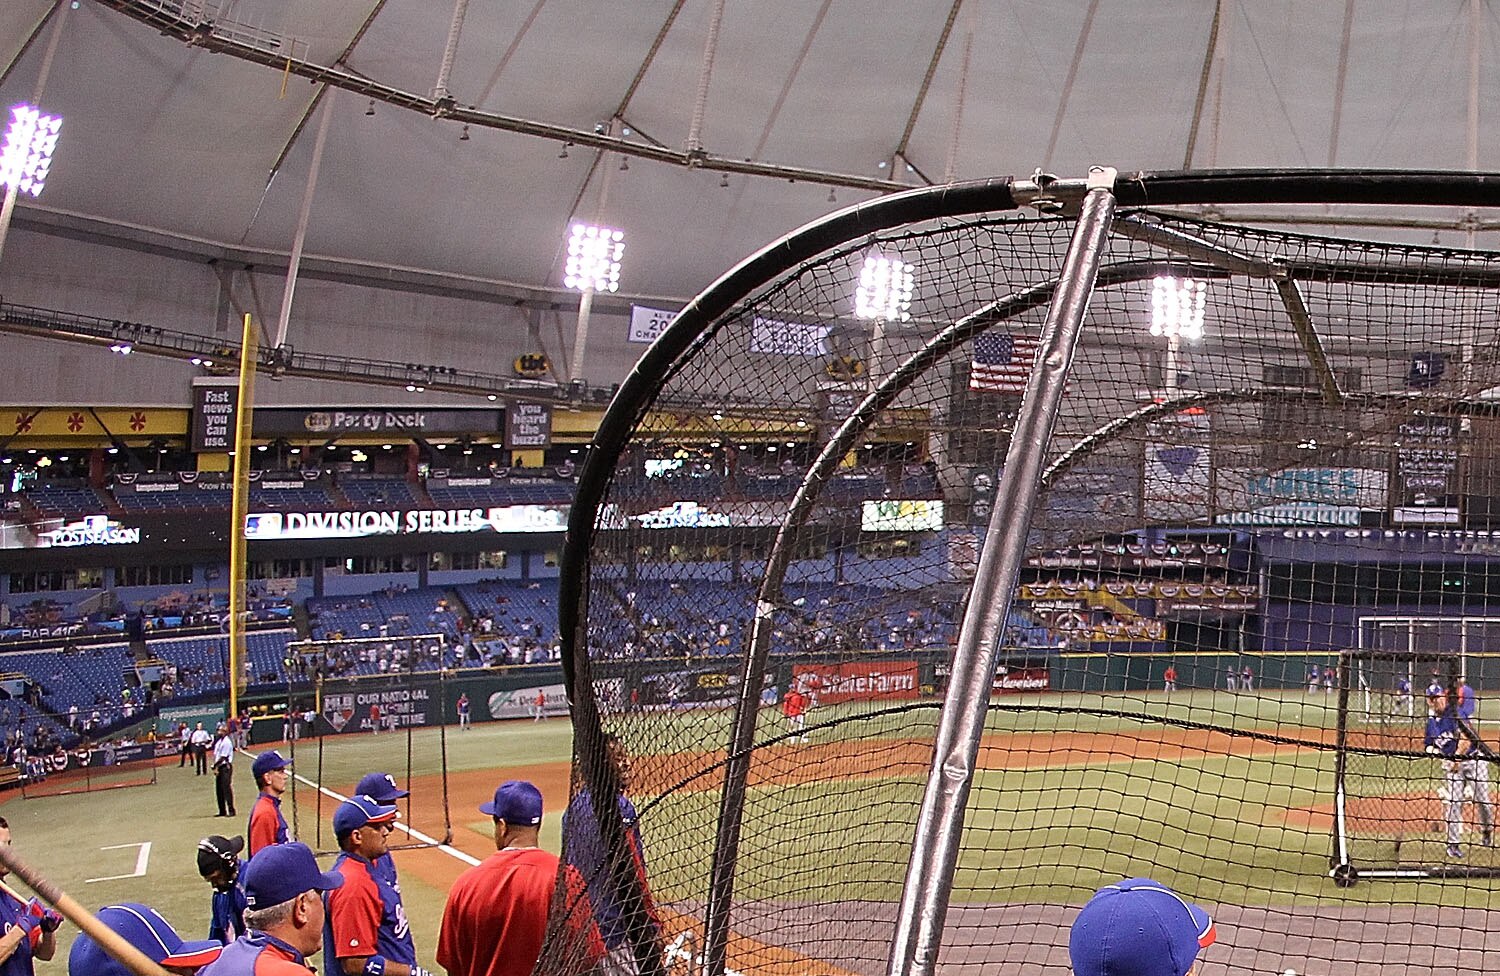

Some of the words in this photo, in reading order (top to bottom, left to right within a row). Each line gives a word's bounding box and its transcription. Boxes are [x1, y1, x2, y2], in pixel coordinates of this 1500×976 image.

[649, 319, 668, 331] 20
[205, 390, 229, 403] Fast
[203, 403, 233, 413] news
[519, 404, 542, 416] you
[206, 414, 228, 426] you
[512, 412, 548, 425] heard
[206, 425, 227, 436] can
[519, 423, 540, 435] the
[204, 437, 228, 447] use.
[511, 434, 546, 446] buzz?
[287, 510, 400, 535] DIVISION
[405, 507, 485, 535] SERIES
[53, 527, 141, 547] POSTSEASON
[22, 628, 50, 640] BAR
[357, 693, 380, 706] OUR
